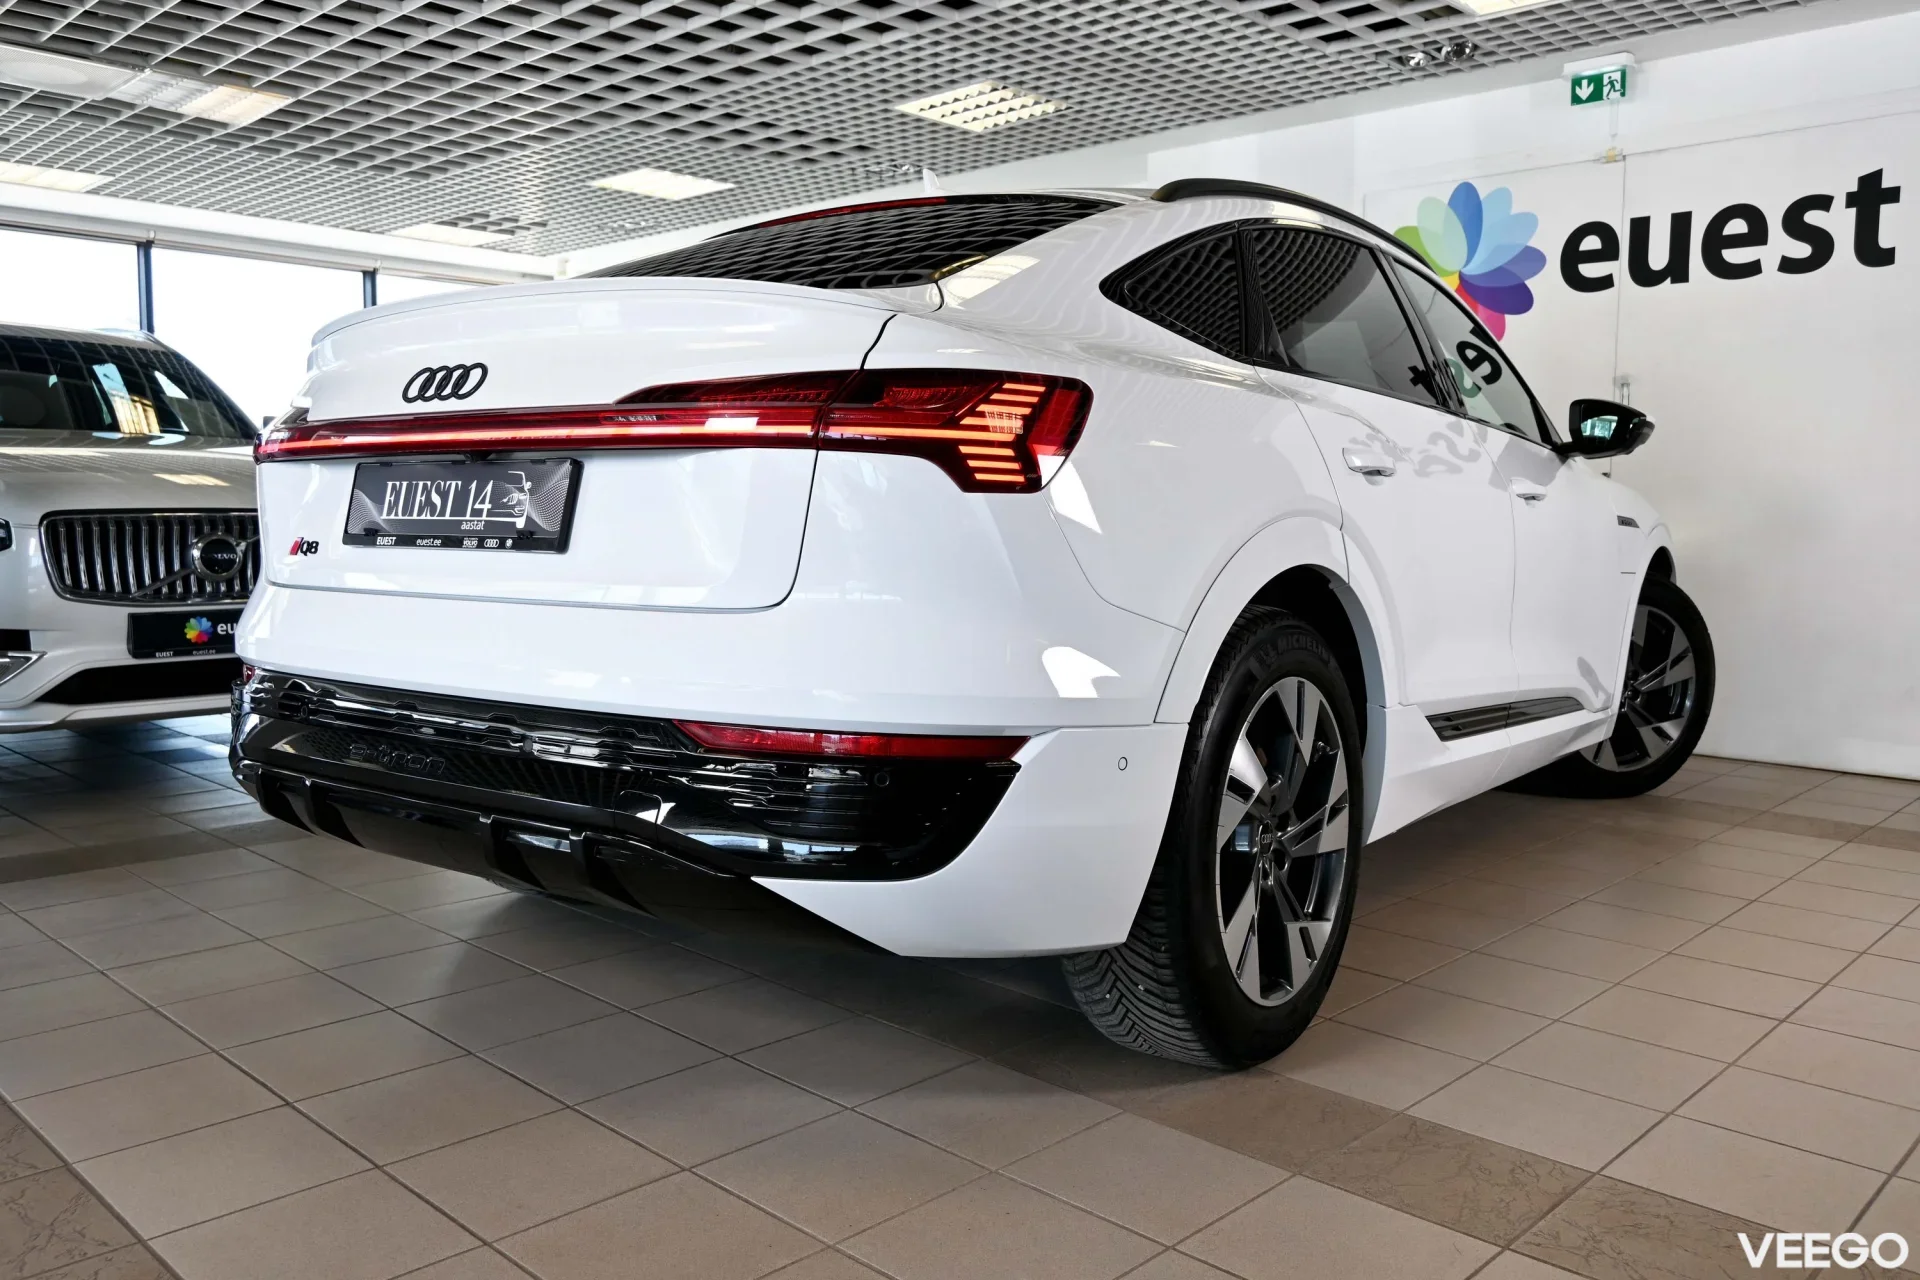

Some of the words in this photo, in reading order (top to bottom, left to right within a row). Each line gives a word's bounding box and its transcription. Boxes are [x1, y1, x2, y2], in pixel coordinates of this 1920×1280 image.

[1559, 168, 1901, 293] euest
[381, 480, 462, 519] EUEST
[466, 480, 493, 519] 14
[461, 520, 486, 530] aastat
[300, 540, 319, 556] Q8
[376, 536, 397, 546] EUEST
[416, 538, 442, 547] euest.ee
[217, 622, 236, 635] eu
[1277, 634, 1329, 661] MICHELIN
[349, 743, 446, 775] e-tron
